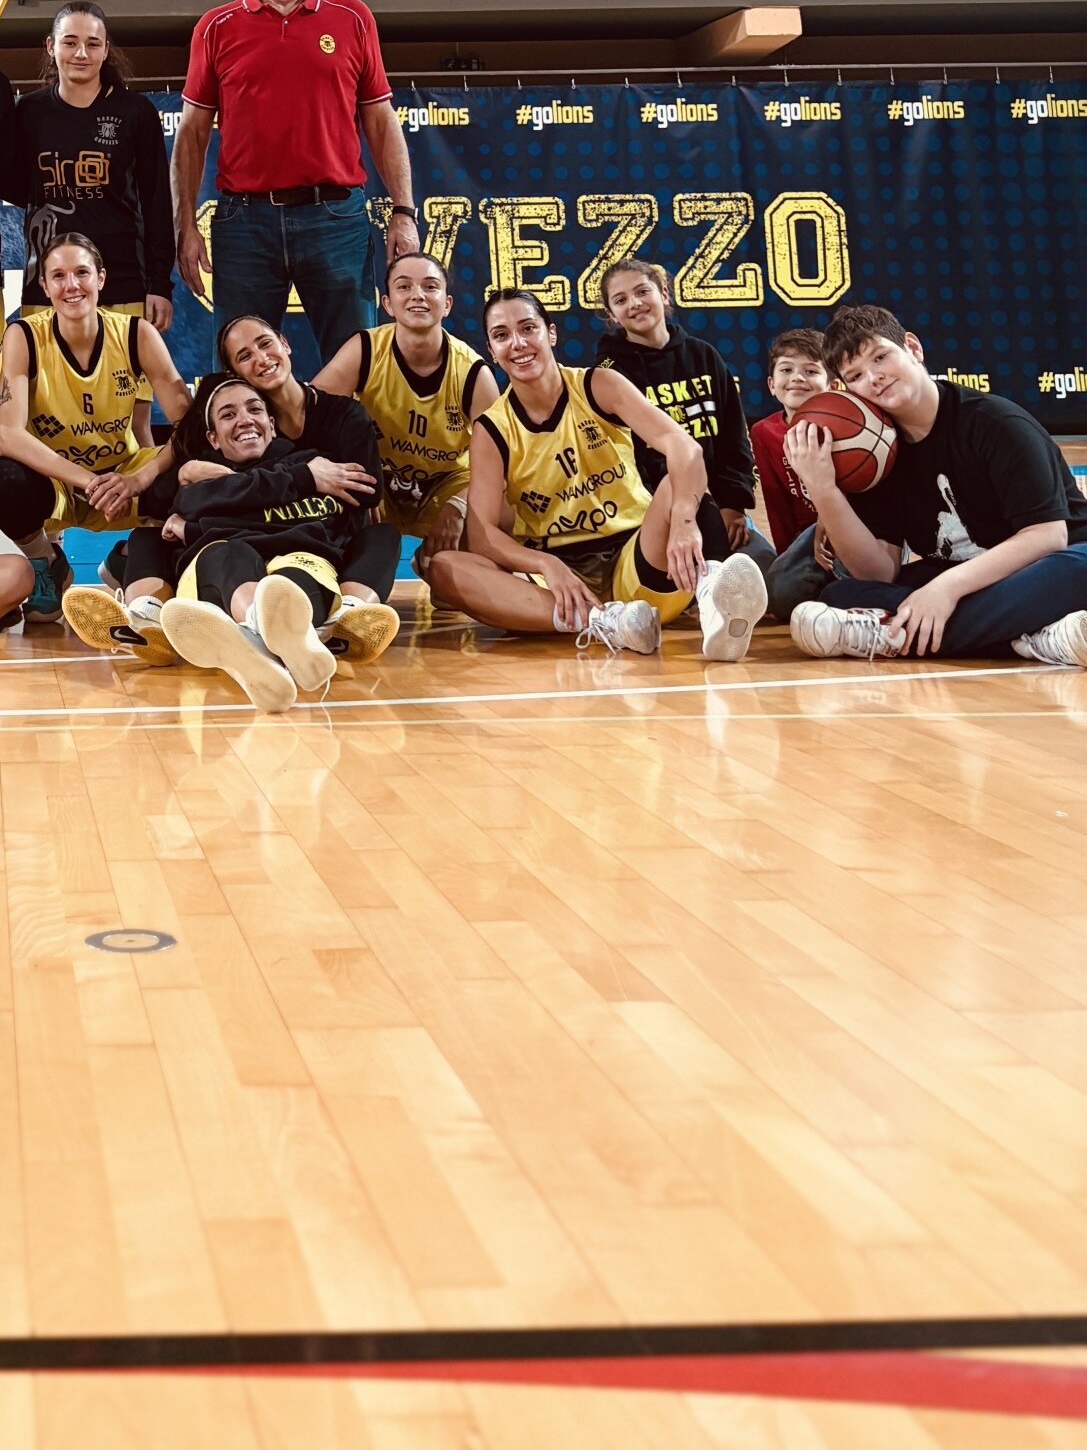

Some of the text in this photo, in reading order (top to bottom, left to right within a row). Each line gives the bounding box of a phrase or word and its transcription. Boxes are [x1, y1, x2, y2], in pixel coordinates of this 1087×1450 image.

[397, 101, 469, 132] #golions
[516, 100, 594, 131] #golions
[640, 97, 718, 128] #golions
[764, 96, 842, 127] #golions
[887, 94, 965, 126] #golions
[43, 186, 104, 200] FITNESS
[82, 392, 94, 416] 6
[645, 374, 713, 407] ASKET
[408, 409, 428, 438] 10
[555, 461, 627, 503] WAMGROU
